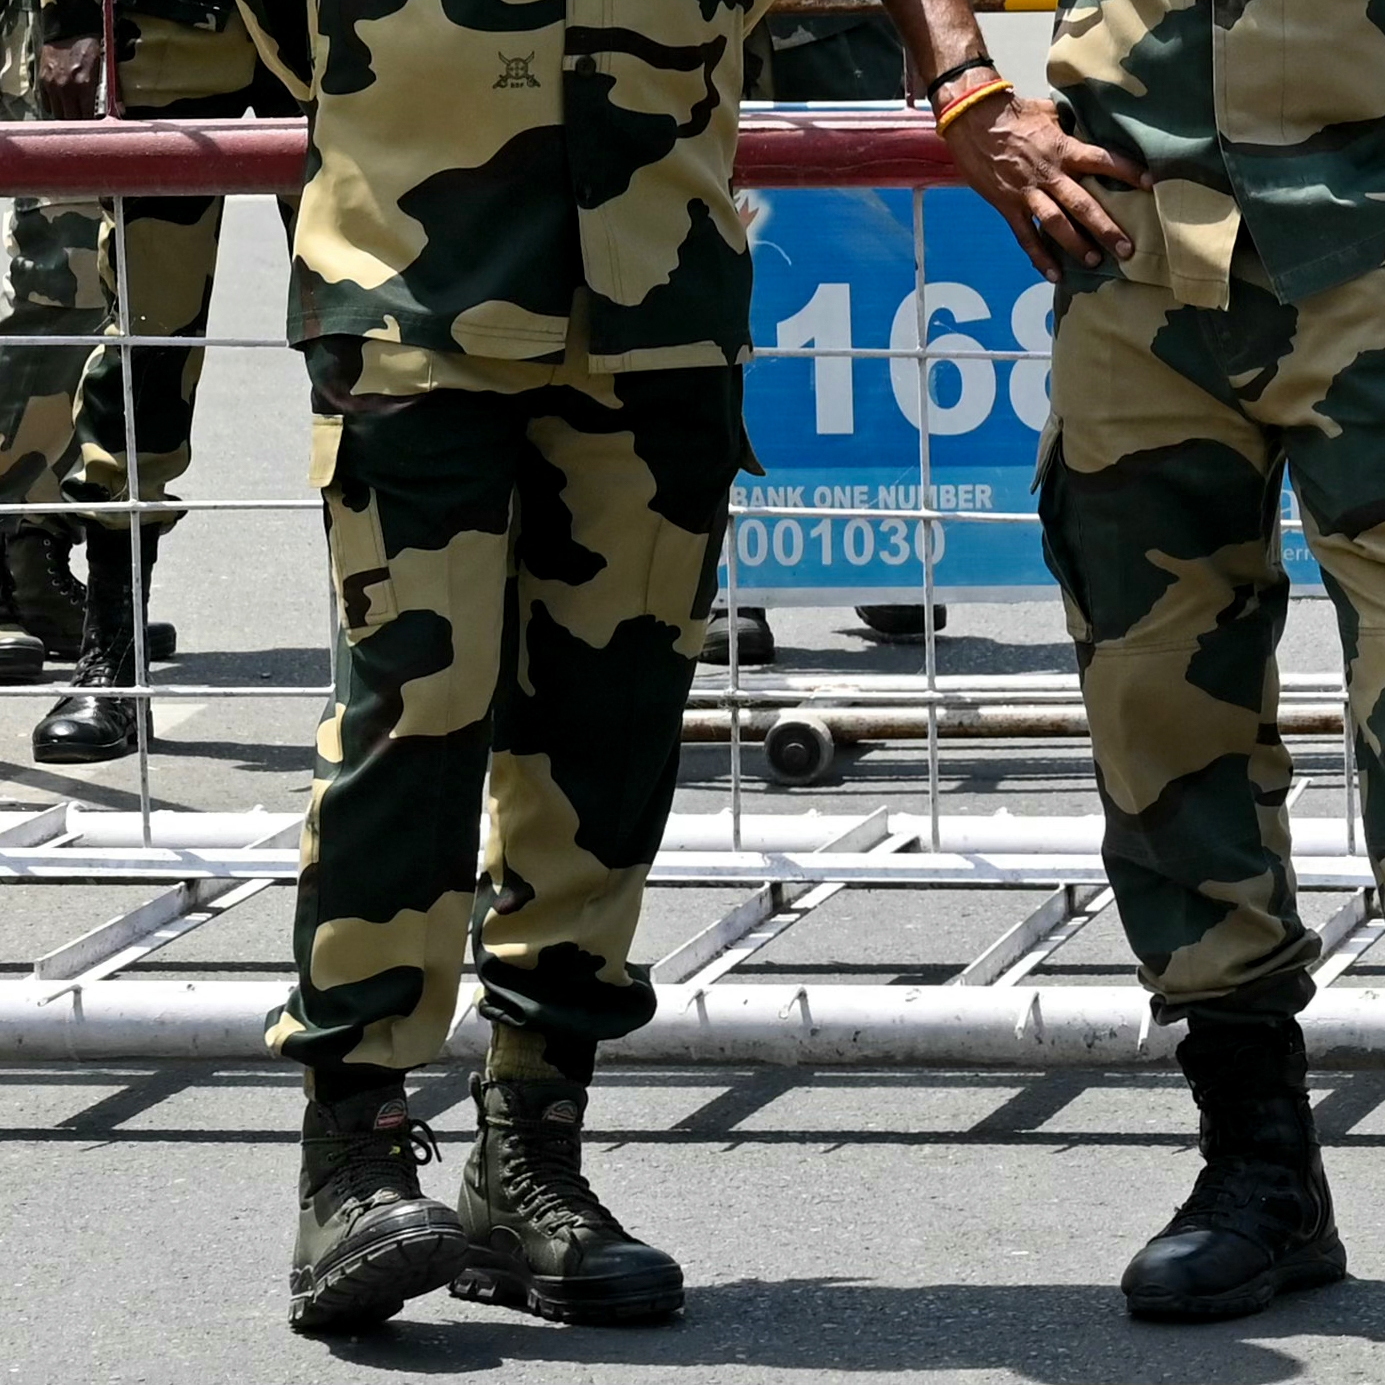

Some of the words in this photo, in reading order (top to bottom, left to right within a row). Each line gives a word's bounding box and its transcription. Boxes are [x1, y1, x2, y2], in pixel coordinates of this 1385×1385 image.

[732, 486, 806, 508] BANK
[814, 486, 870, 508] ONE
[878, 484, 993, 510] NUMBER
[719, 518, 946, 567] 001030
